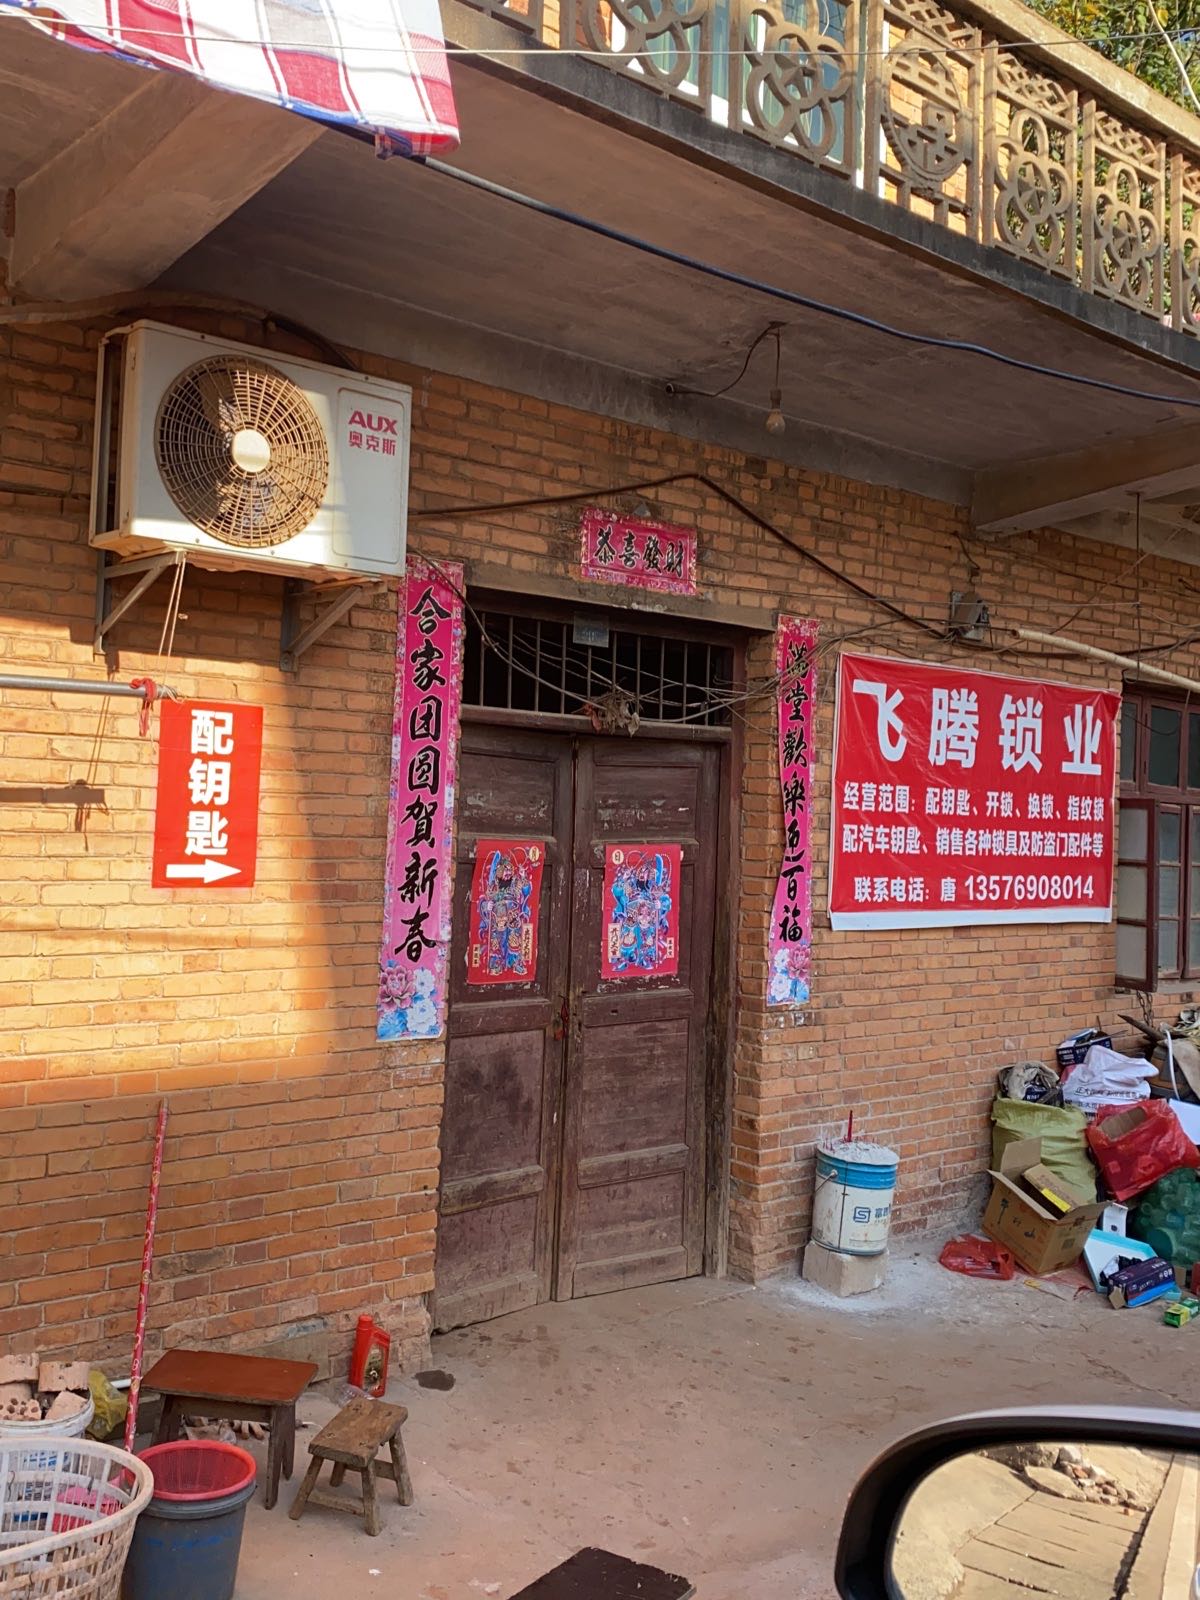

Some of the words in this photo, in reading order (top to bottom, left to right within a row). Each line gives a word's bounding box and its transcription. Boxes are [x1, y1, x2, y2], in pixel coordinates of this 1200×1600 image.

[348, 410, 398, 436] AUX
[349, 430, 397, 456] 奥克斯
[853, 679, 1102, 776] 飞腾锁业
[184, 709, 234, 856] 配钥匙
[964, 875, 1094, 900] 13576908014
